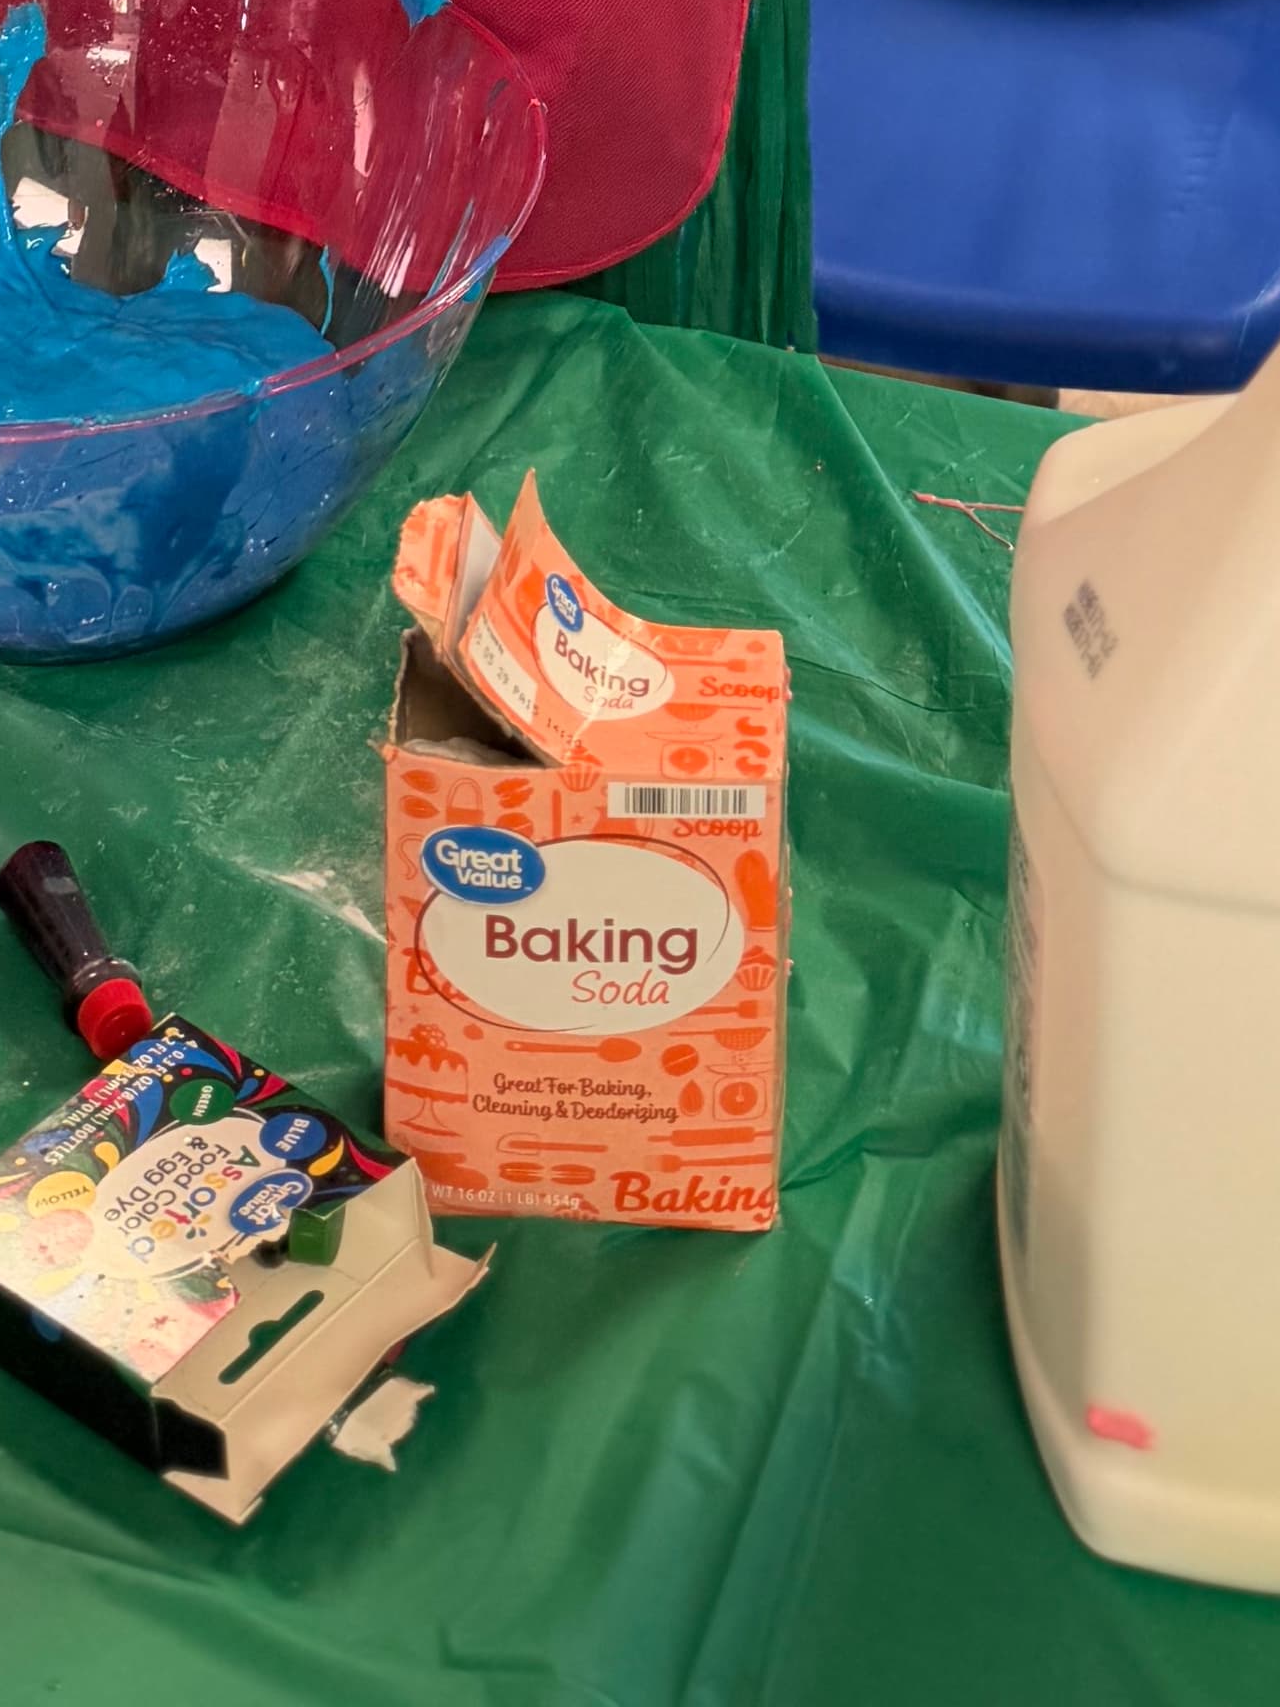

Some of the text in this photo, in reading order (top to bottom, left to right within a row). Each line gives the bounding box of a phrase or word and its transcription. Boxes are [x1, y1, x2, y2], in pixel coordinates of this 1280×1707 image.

[554, 629, 650, 697] Baking
[583, 686, 634, 709] Soda
[699, 676, 780, 703] Scoop
[435, 838, 522, 873] Great
[456, 867, 522, 889] Value
[485, 914, 698, 975] Baking
[571, 969, 670, 1006] Soda
[133, 1054, 153, 1069] OZ
[149, 1043, 167, 1055] FL
[133, 1075, 153, 1091] OZ
[494, 1072, 652, 1100] Great For Baking,
[61, 1098, 101, 1128] TOTAL
[192, 1085, 214, 1117] GREEN
[472, 1094, 680, 1124] Cleaning & Deodorizing
[44, 1121, 97, 1165] BOTTLES
[275, 1118, 310, 1152] BLUE
[104, 1136, 209, 1222] & Egg Dye
[118, 1143, 231, 1237] Food Color
[34, 1183, 92, 1208] YELLOW
[125, 1144, 262, 1265] Assorted
[238, 1184, 279, 1217] Value
[431, 1184, 453, 1198] WT
[458, 1188, 474, 1202] 16
[478, 1190, 495, 1203] OZ
[543, 1193, 580, 1210] 454g
[608, 1170, 776, 1224] Baking
